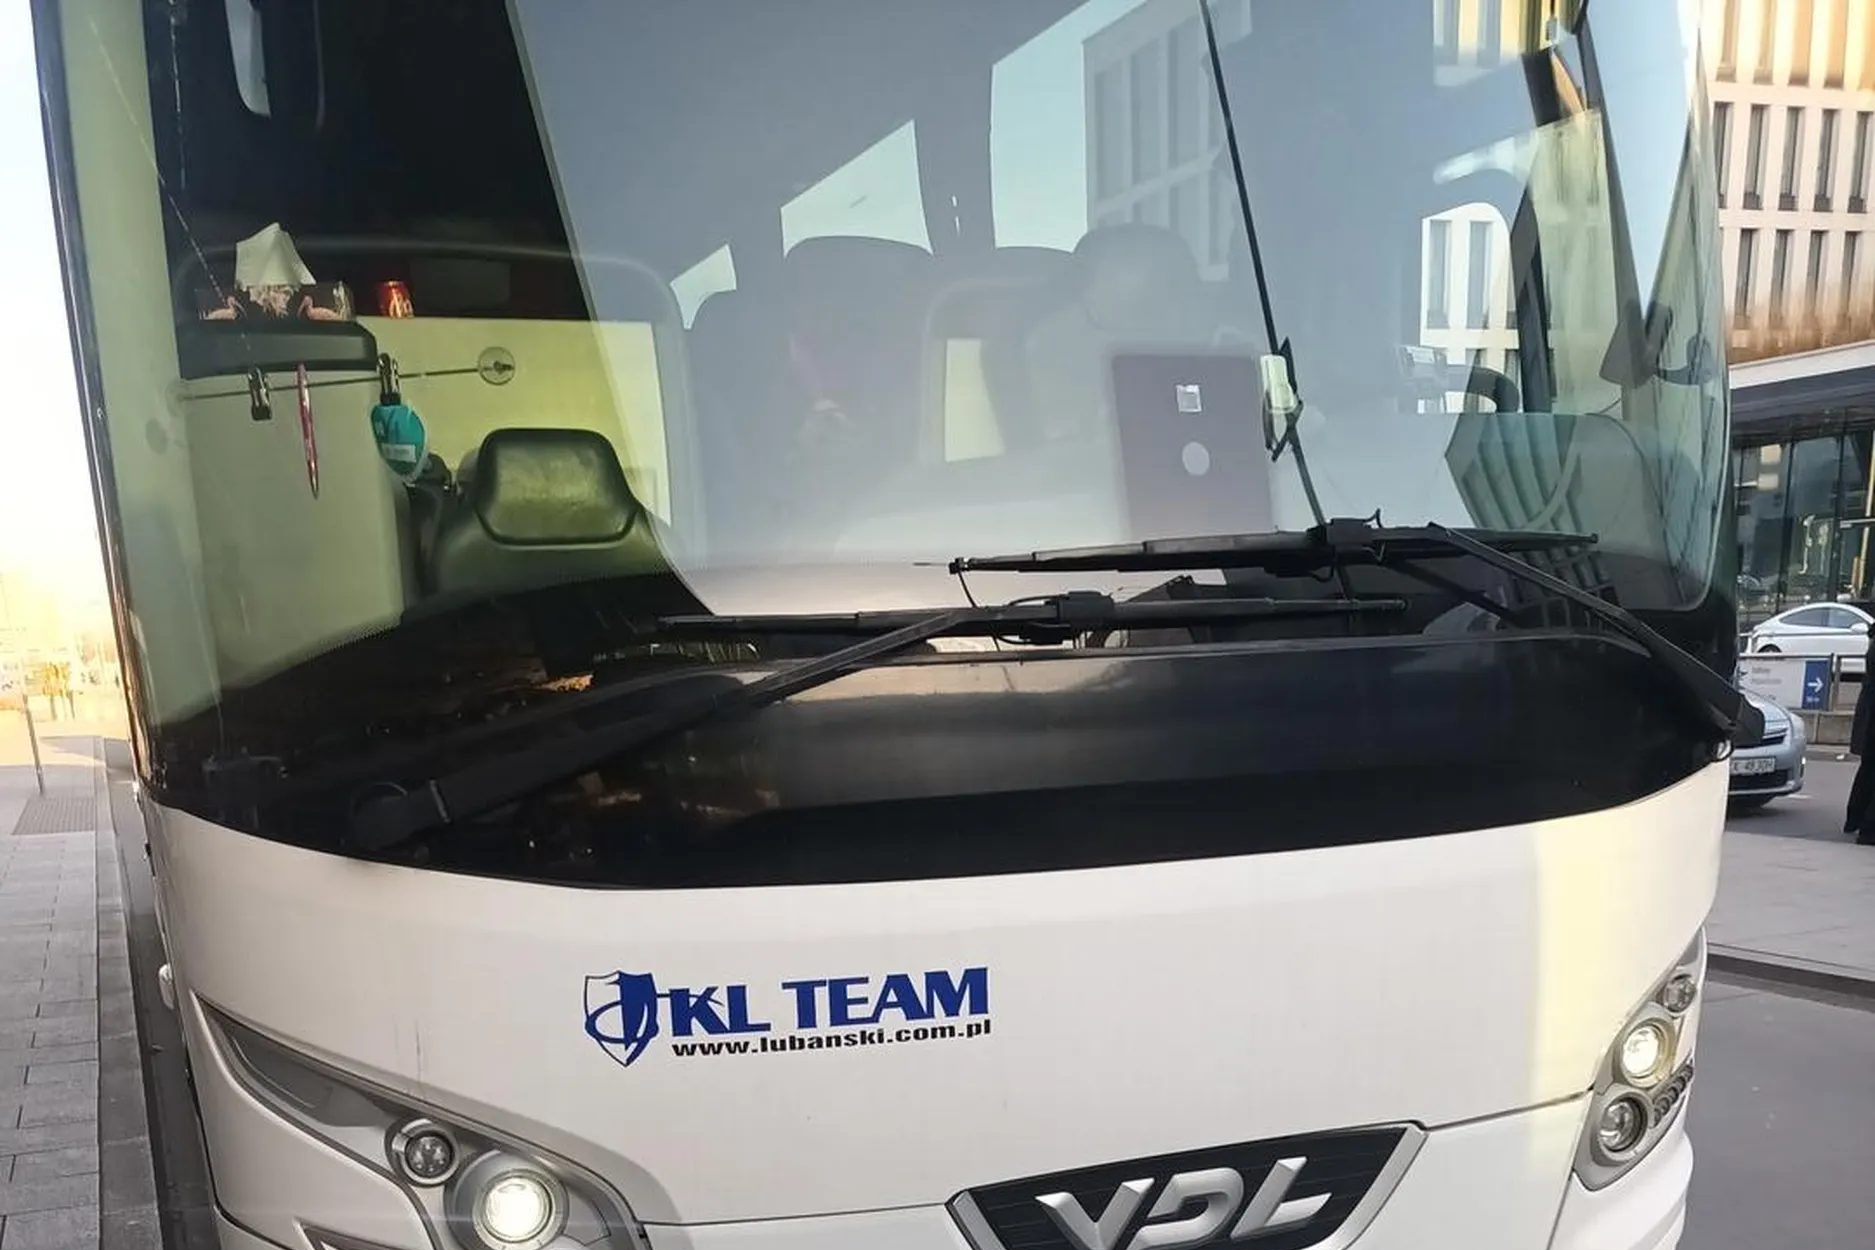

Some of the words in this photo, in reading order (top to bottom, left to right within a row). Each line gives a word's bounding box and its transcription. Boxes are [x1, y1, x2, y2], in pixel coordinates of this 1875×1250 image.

[669, 985, 771, 1037] KL
[781, 967, 989, 1030] TEAM
[671, 1019, 991, 1057] www.lubanski.com.pl
